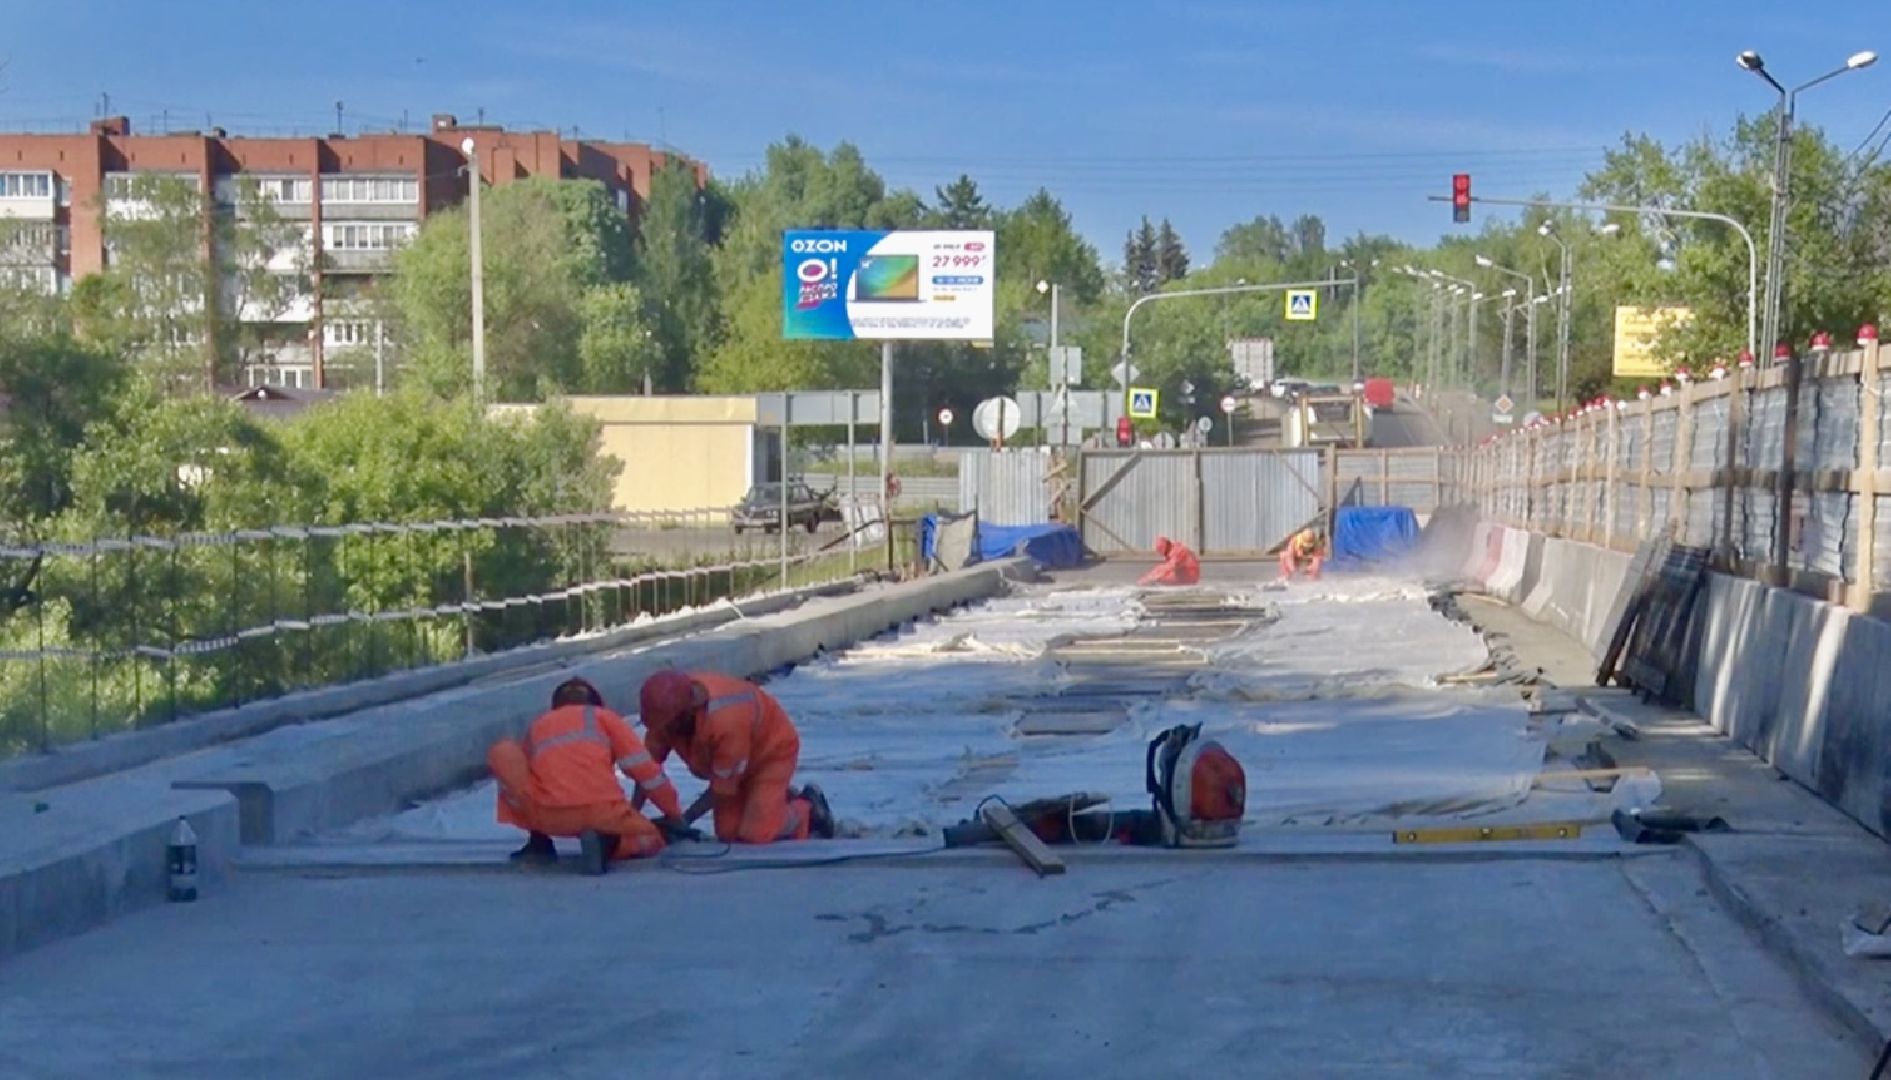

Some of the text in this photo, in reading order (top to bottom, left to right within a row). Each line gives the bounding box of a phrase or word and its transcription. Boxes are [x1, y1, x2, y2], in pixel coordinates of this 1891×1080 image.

[791, 240, 847, 252] OZON
[933, 255, 949, 267] 27
[953, 255, 979, 267] 999
